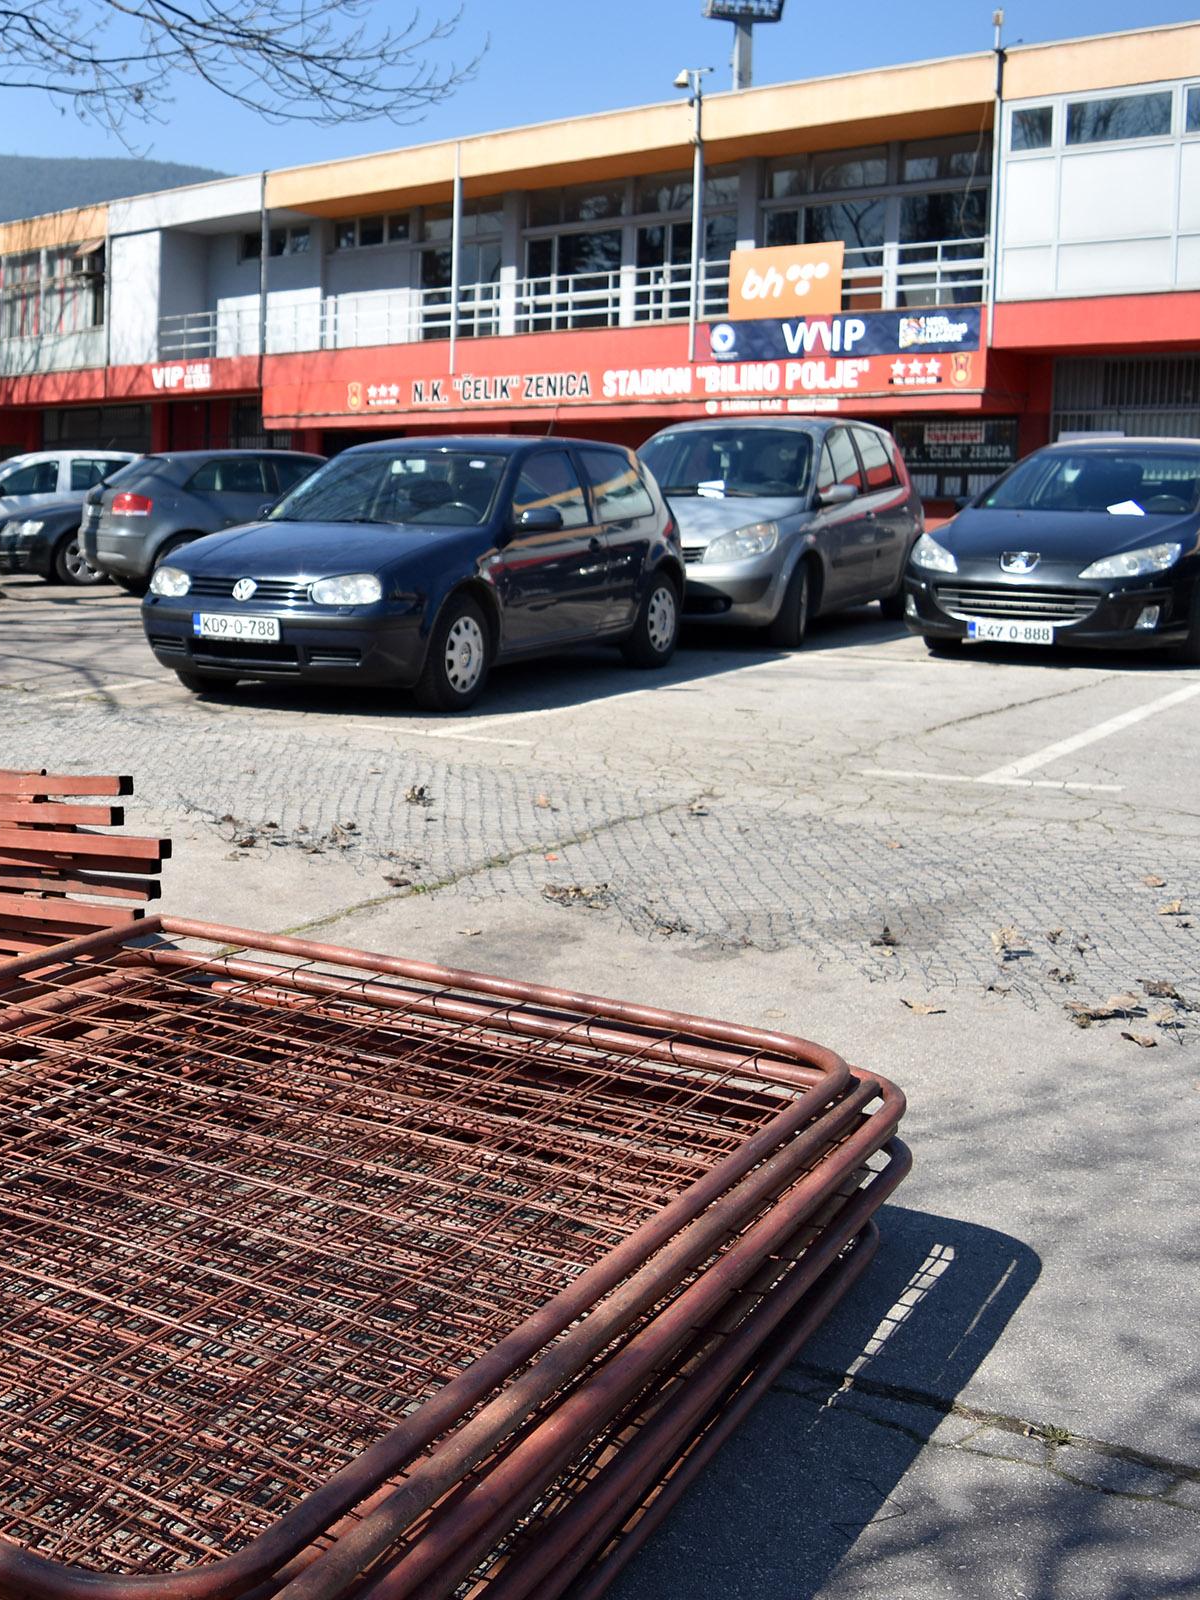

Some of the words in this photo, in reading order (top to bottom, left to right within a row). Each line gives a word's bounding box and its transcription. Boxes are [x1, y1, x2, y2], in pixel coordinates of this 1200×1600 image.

[151, 366, 184, 389] VIP
[412, 380, 449, 403] N.K.
[524, 373, 591, 399] ZENICA
[603, 367, 691, 397] STADION
[696, 362, 780, 393] "BILINO
[785, 359, 870, 389] POLJE"
